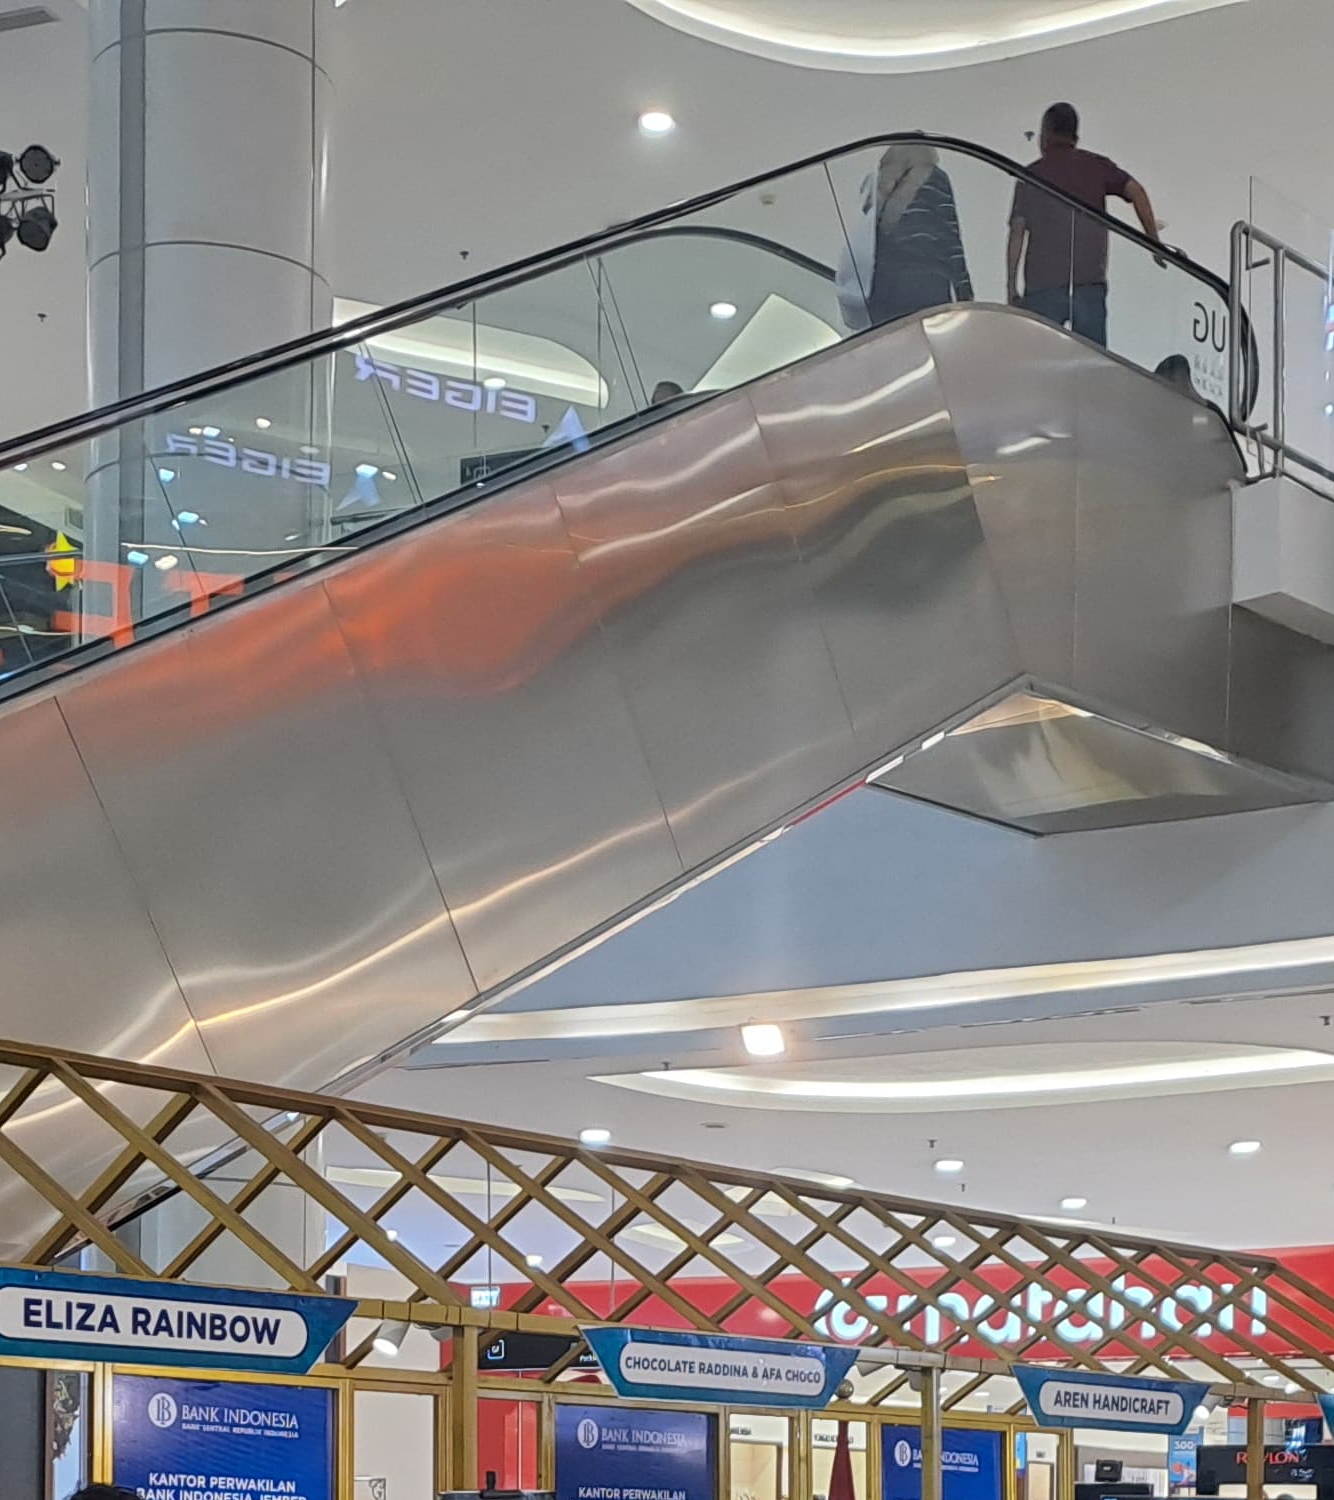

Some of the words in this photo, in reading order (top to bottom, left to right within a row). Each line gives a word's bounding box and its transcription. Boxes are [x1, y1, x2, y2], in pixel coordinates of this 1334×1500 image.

[23, 1297, 121, 1334] ELIZA
[131, 1306, 282, 1346] RAINBOW
[624, 1355, 696, 1375] CHOCOLATE
[698, 1361, 749, 1379] RADDINA
[751, 1365, 759, 1380] &
[761, 1366, 783, 1382] AFA
[785, 1368, 821, 1385] CHOCO
[1054, 1389, 1090, 1410] AREN
[1092, 1393, 1171, 1416] HANDICRAFT
[181, 1404, 220, 1424] BANK
[223, 1408, 300, 1430] INDONESIA
[601, 1427, 629, 1443] BANK
[1237, 1451, 1301, 1466] RLON
[148, 1472, 206, 1490] KANTOR
[210, 1476, 296, 1494] PERWAKILAN
[578, 1486, 621, 1500] KANTOR
